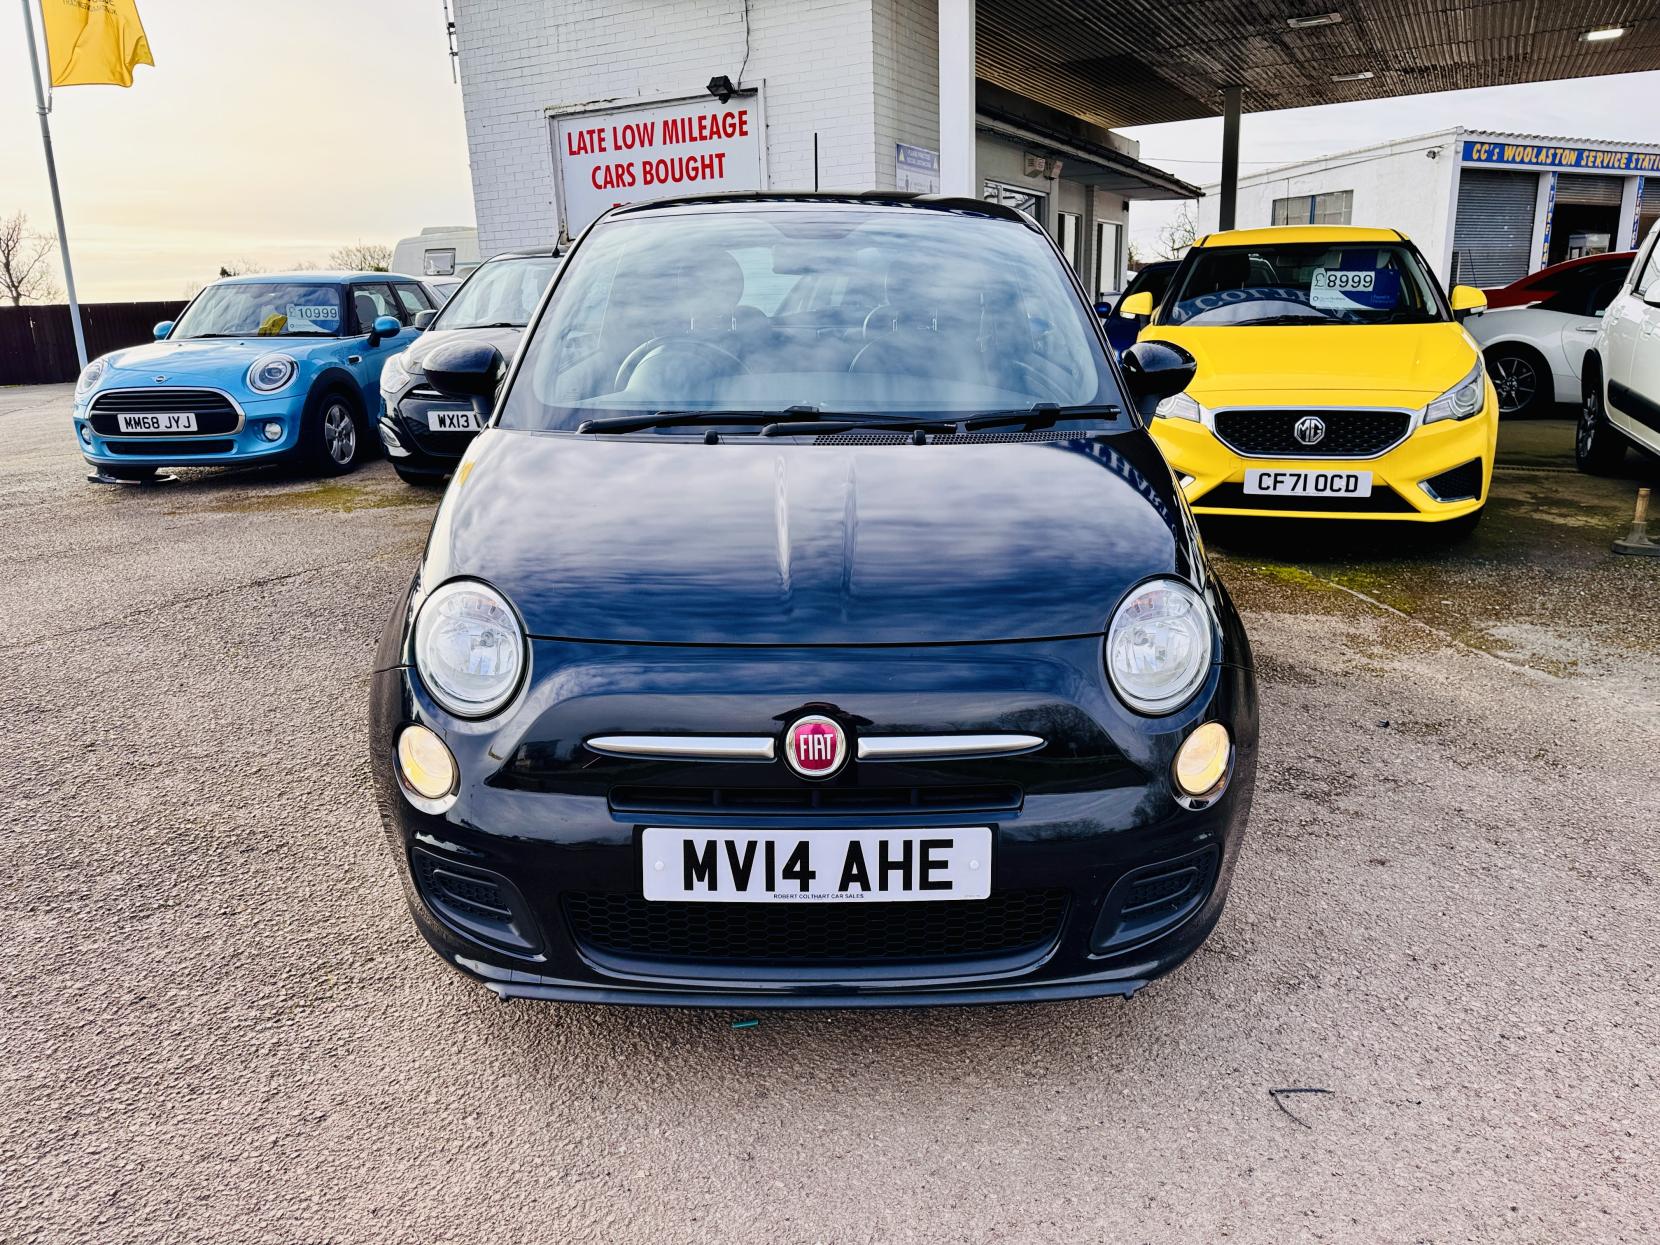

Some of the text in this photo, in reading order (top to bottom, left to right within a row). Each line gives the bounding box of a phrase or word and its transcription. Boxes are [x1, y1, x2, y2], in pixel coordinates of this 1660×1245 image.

[567, 109, 749, 156] LATE LOW MILEAGE
[1471, 143, 1660, 171] CC's WOOLASTON SERVICE STATI
[591, 152, 726, 190] CARS BOUGHT
[1314, 272, 1373, 289] £8999
[288, 306, 337, 319] £10999
[165, 415, 191, 429] JYJ
[437, 413, 470, 429] WX13
[1297, 418, 1323, 442] MG
[1258, 472, 1359, 493] CF71 OCD
[799, 733, 833, 761] FIAT
[682, 838, 954, 892] MV14 AHE
